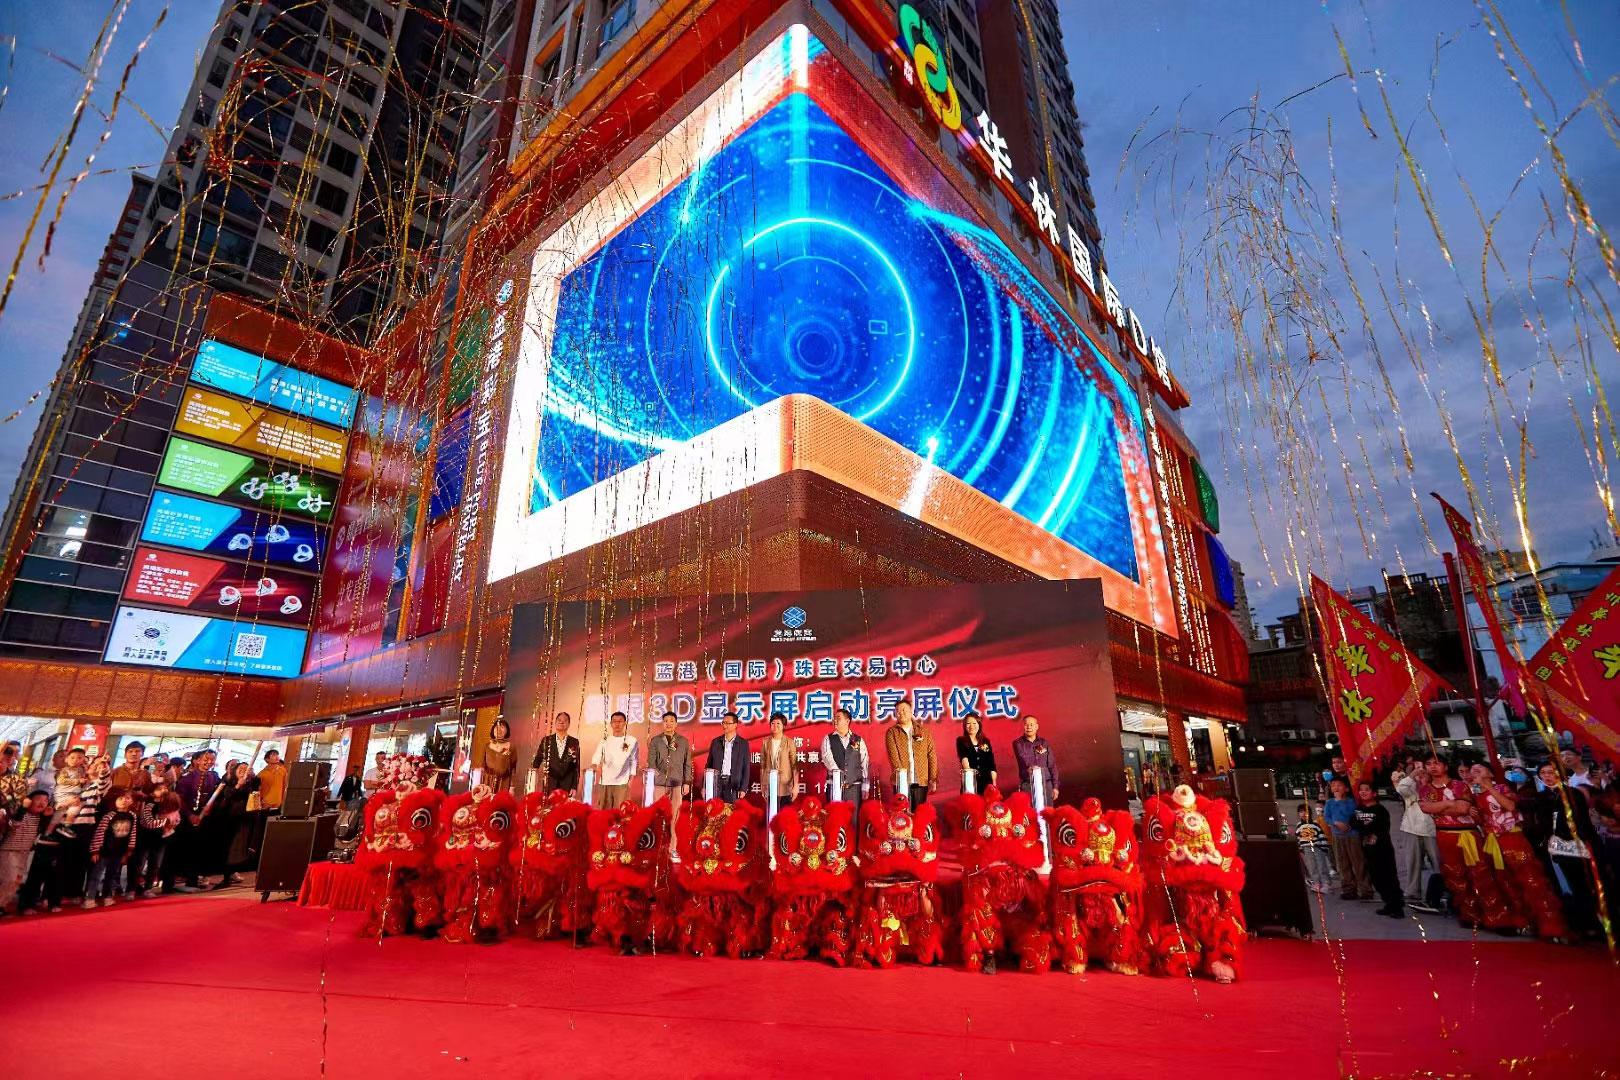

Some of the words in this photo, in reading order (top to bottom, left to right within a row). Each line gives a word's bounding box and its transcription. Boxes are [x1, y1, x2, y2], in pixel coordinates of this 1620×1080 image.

[655, 656, 937, 681] 蓝港（国际）珠宝交易中心
[583, 686, 1020, 725] 眼3D显示屏启动亮屏仪式
